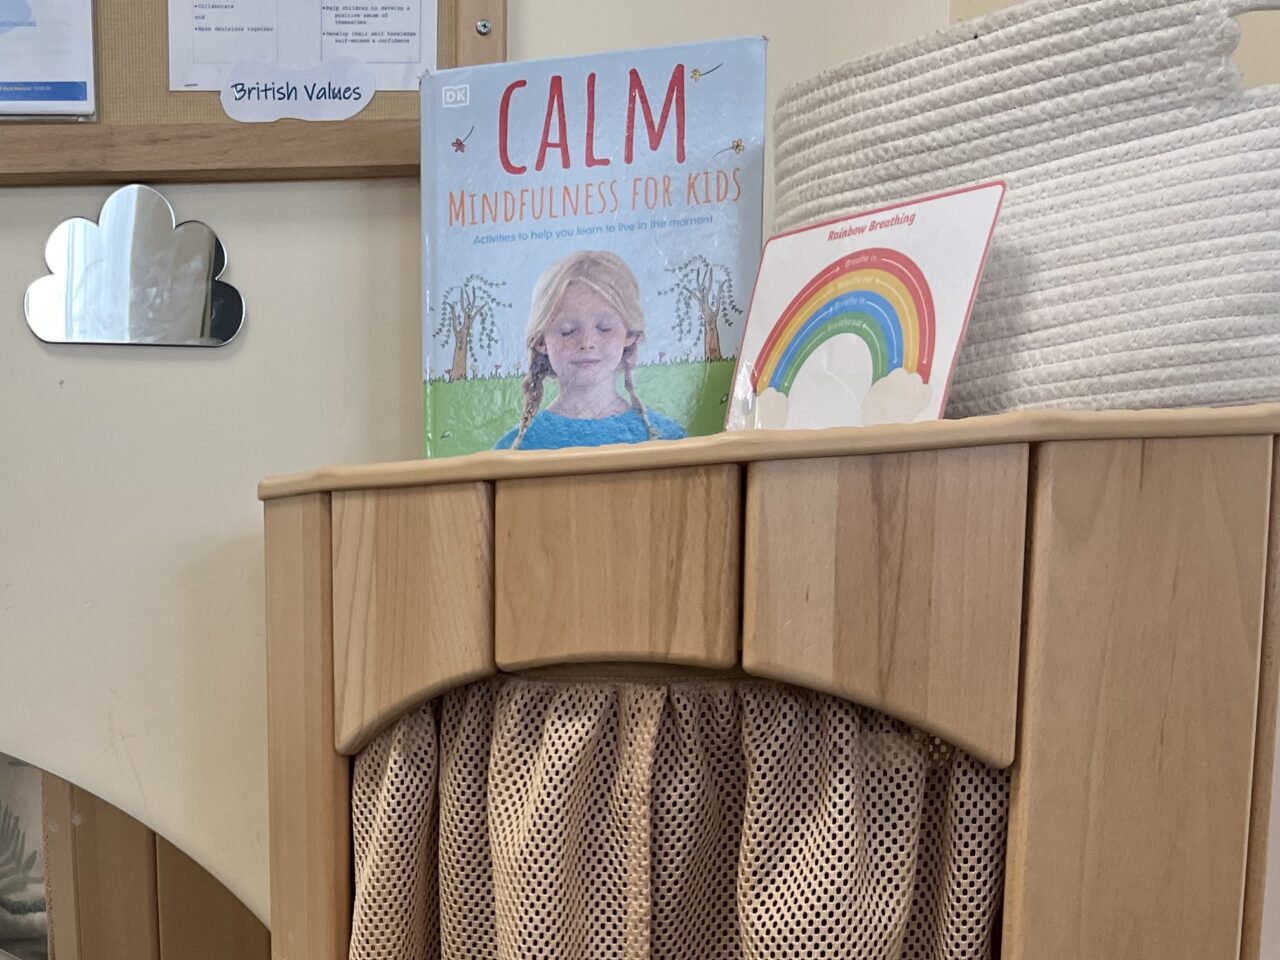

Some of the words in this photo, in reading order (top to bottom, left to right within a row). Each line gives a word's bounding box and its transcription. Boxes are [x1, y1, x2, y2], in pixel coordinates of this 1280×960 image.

[231, 81, 297, 101] British
[303, 81, 362, 101] Values
[446, 89, 466, 103] DK
[497, 62, 687, 175] CALM
[448, 179, 619, 228] MINDFULNESS
[631, 175, 672, 211] FOR
[686, 166, 742, 206] KIDS
[473, 233, 516, 245] Activities
[518, 233, 528, 241] to
[530, 229, 553, 241] help
[555, 229, 574, 239] you
[576, 226, 602, 236] learn
[605, 224, 616, 233] to
[617, 222, 635, 232] live
[637, 220, 648, 230] in
[650, 219, 667, 229] the
[669, 215, 713, 228] moment
[827, 225, 868, 241] Rainbow
[868, 213, 917, 232] Breathing
